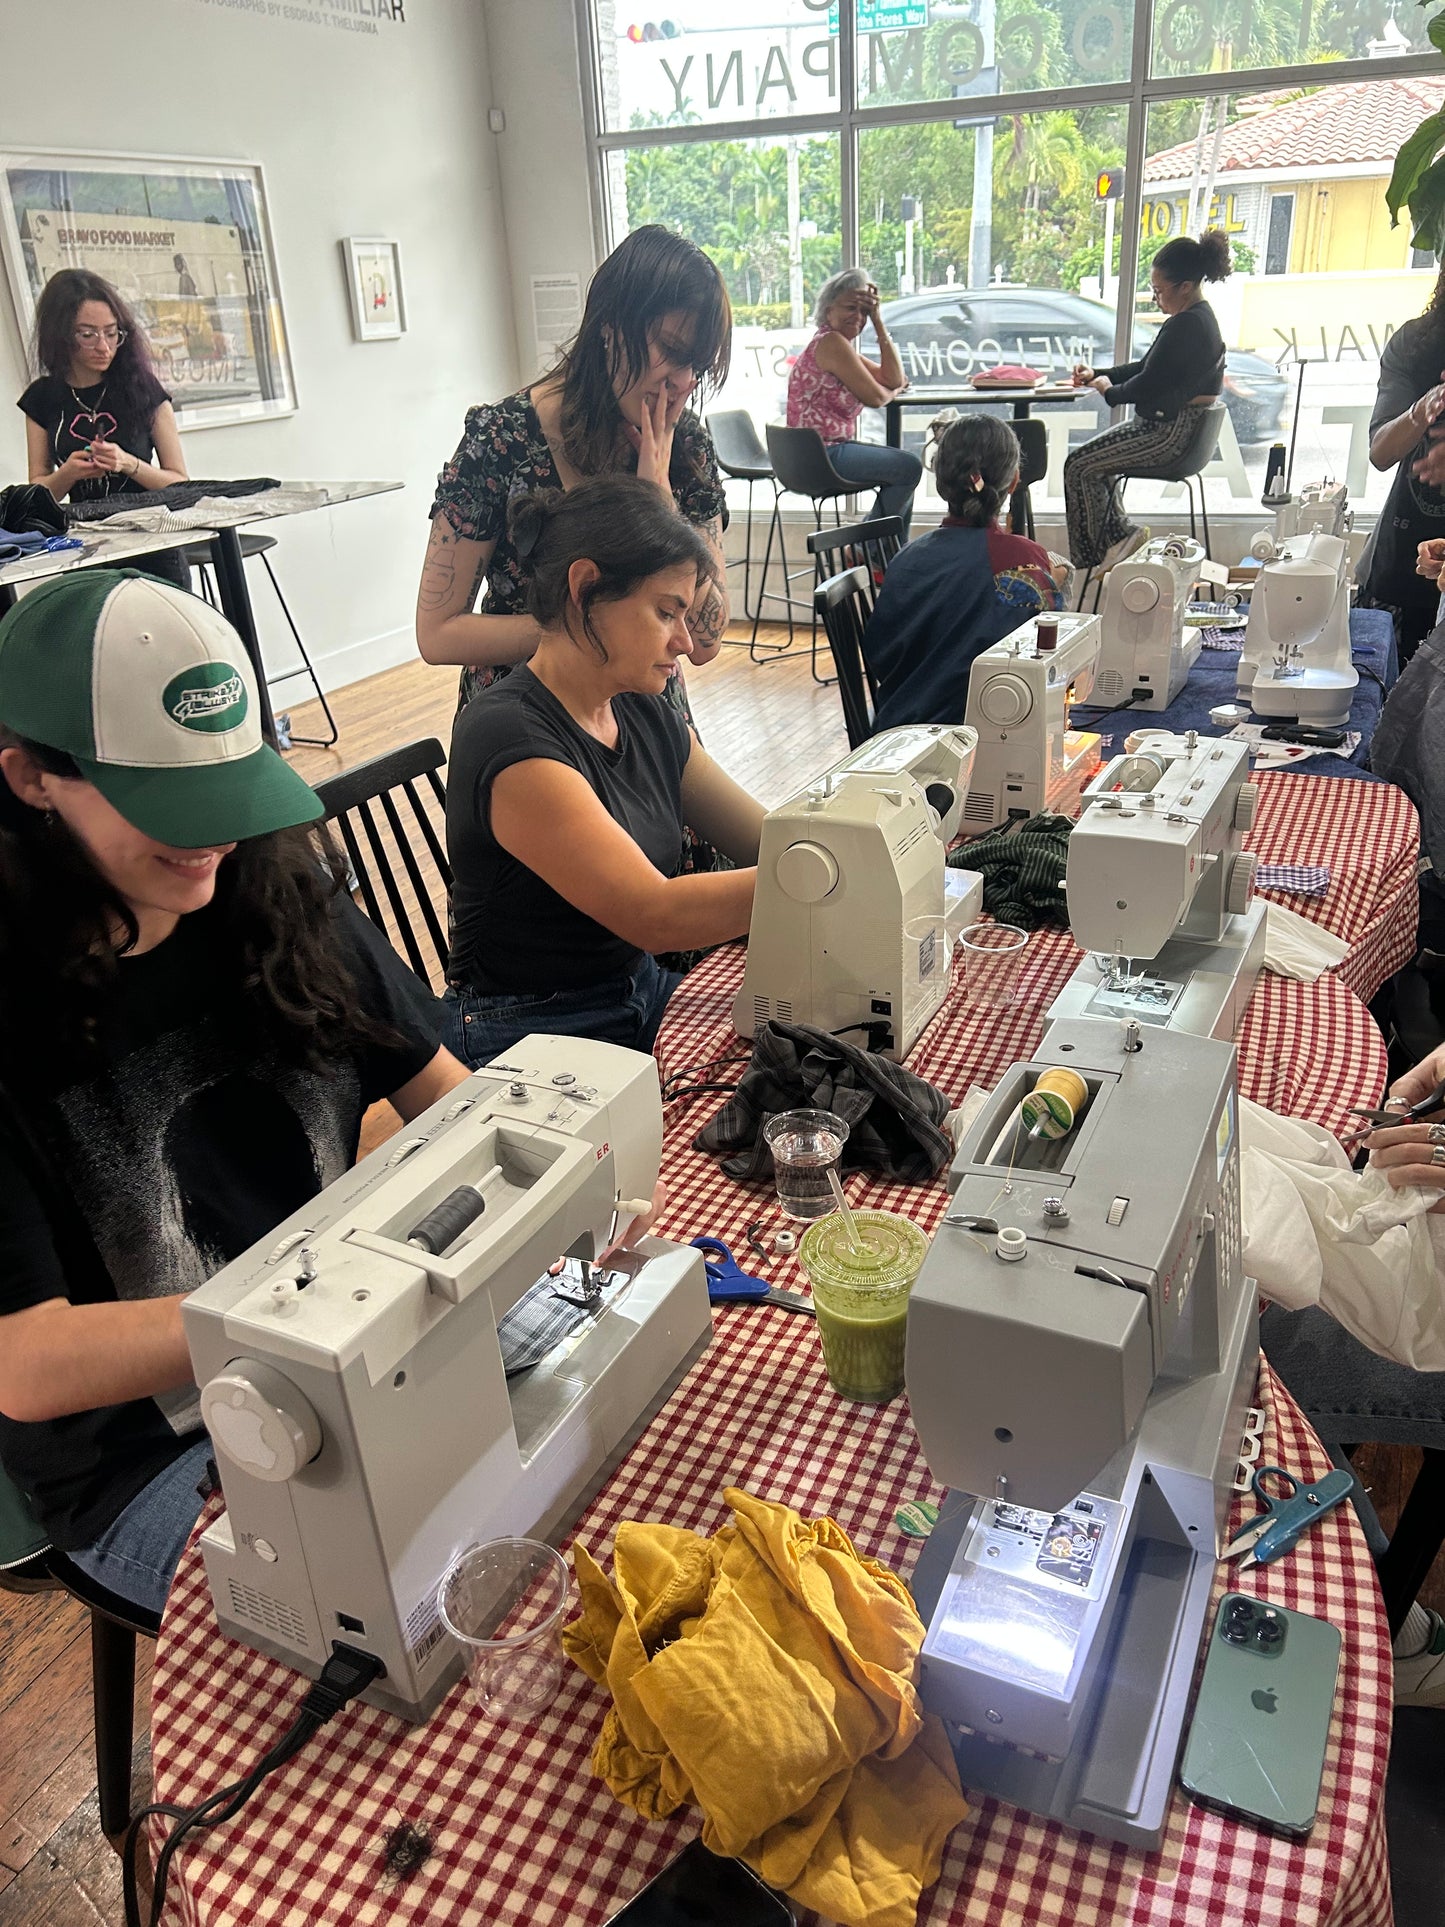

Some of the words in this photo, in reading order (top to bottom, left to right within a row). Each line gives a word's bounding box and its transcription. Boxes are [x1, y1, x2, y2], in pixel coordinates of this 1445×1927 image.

[268, 4, 282, 17] BY
[875, 12, 904, 27] Flores
[905, 9, 925, 26] Way
[57, 229, 99, 245] BRAVO
[100, 230, 133, 245] FOOD
[133, 231, 175, 246] MARKET
